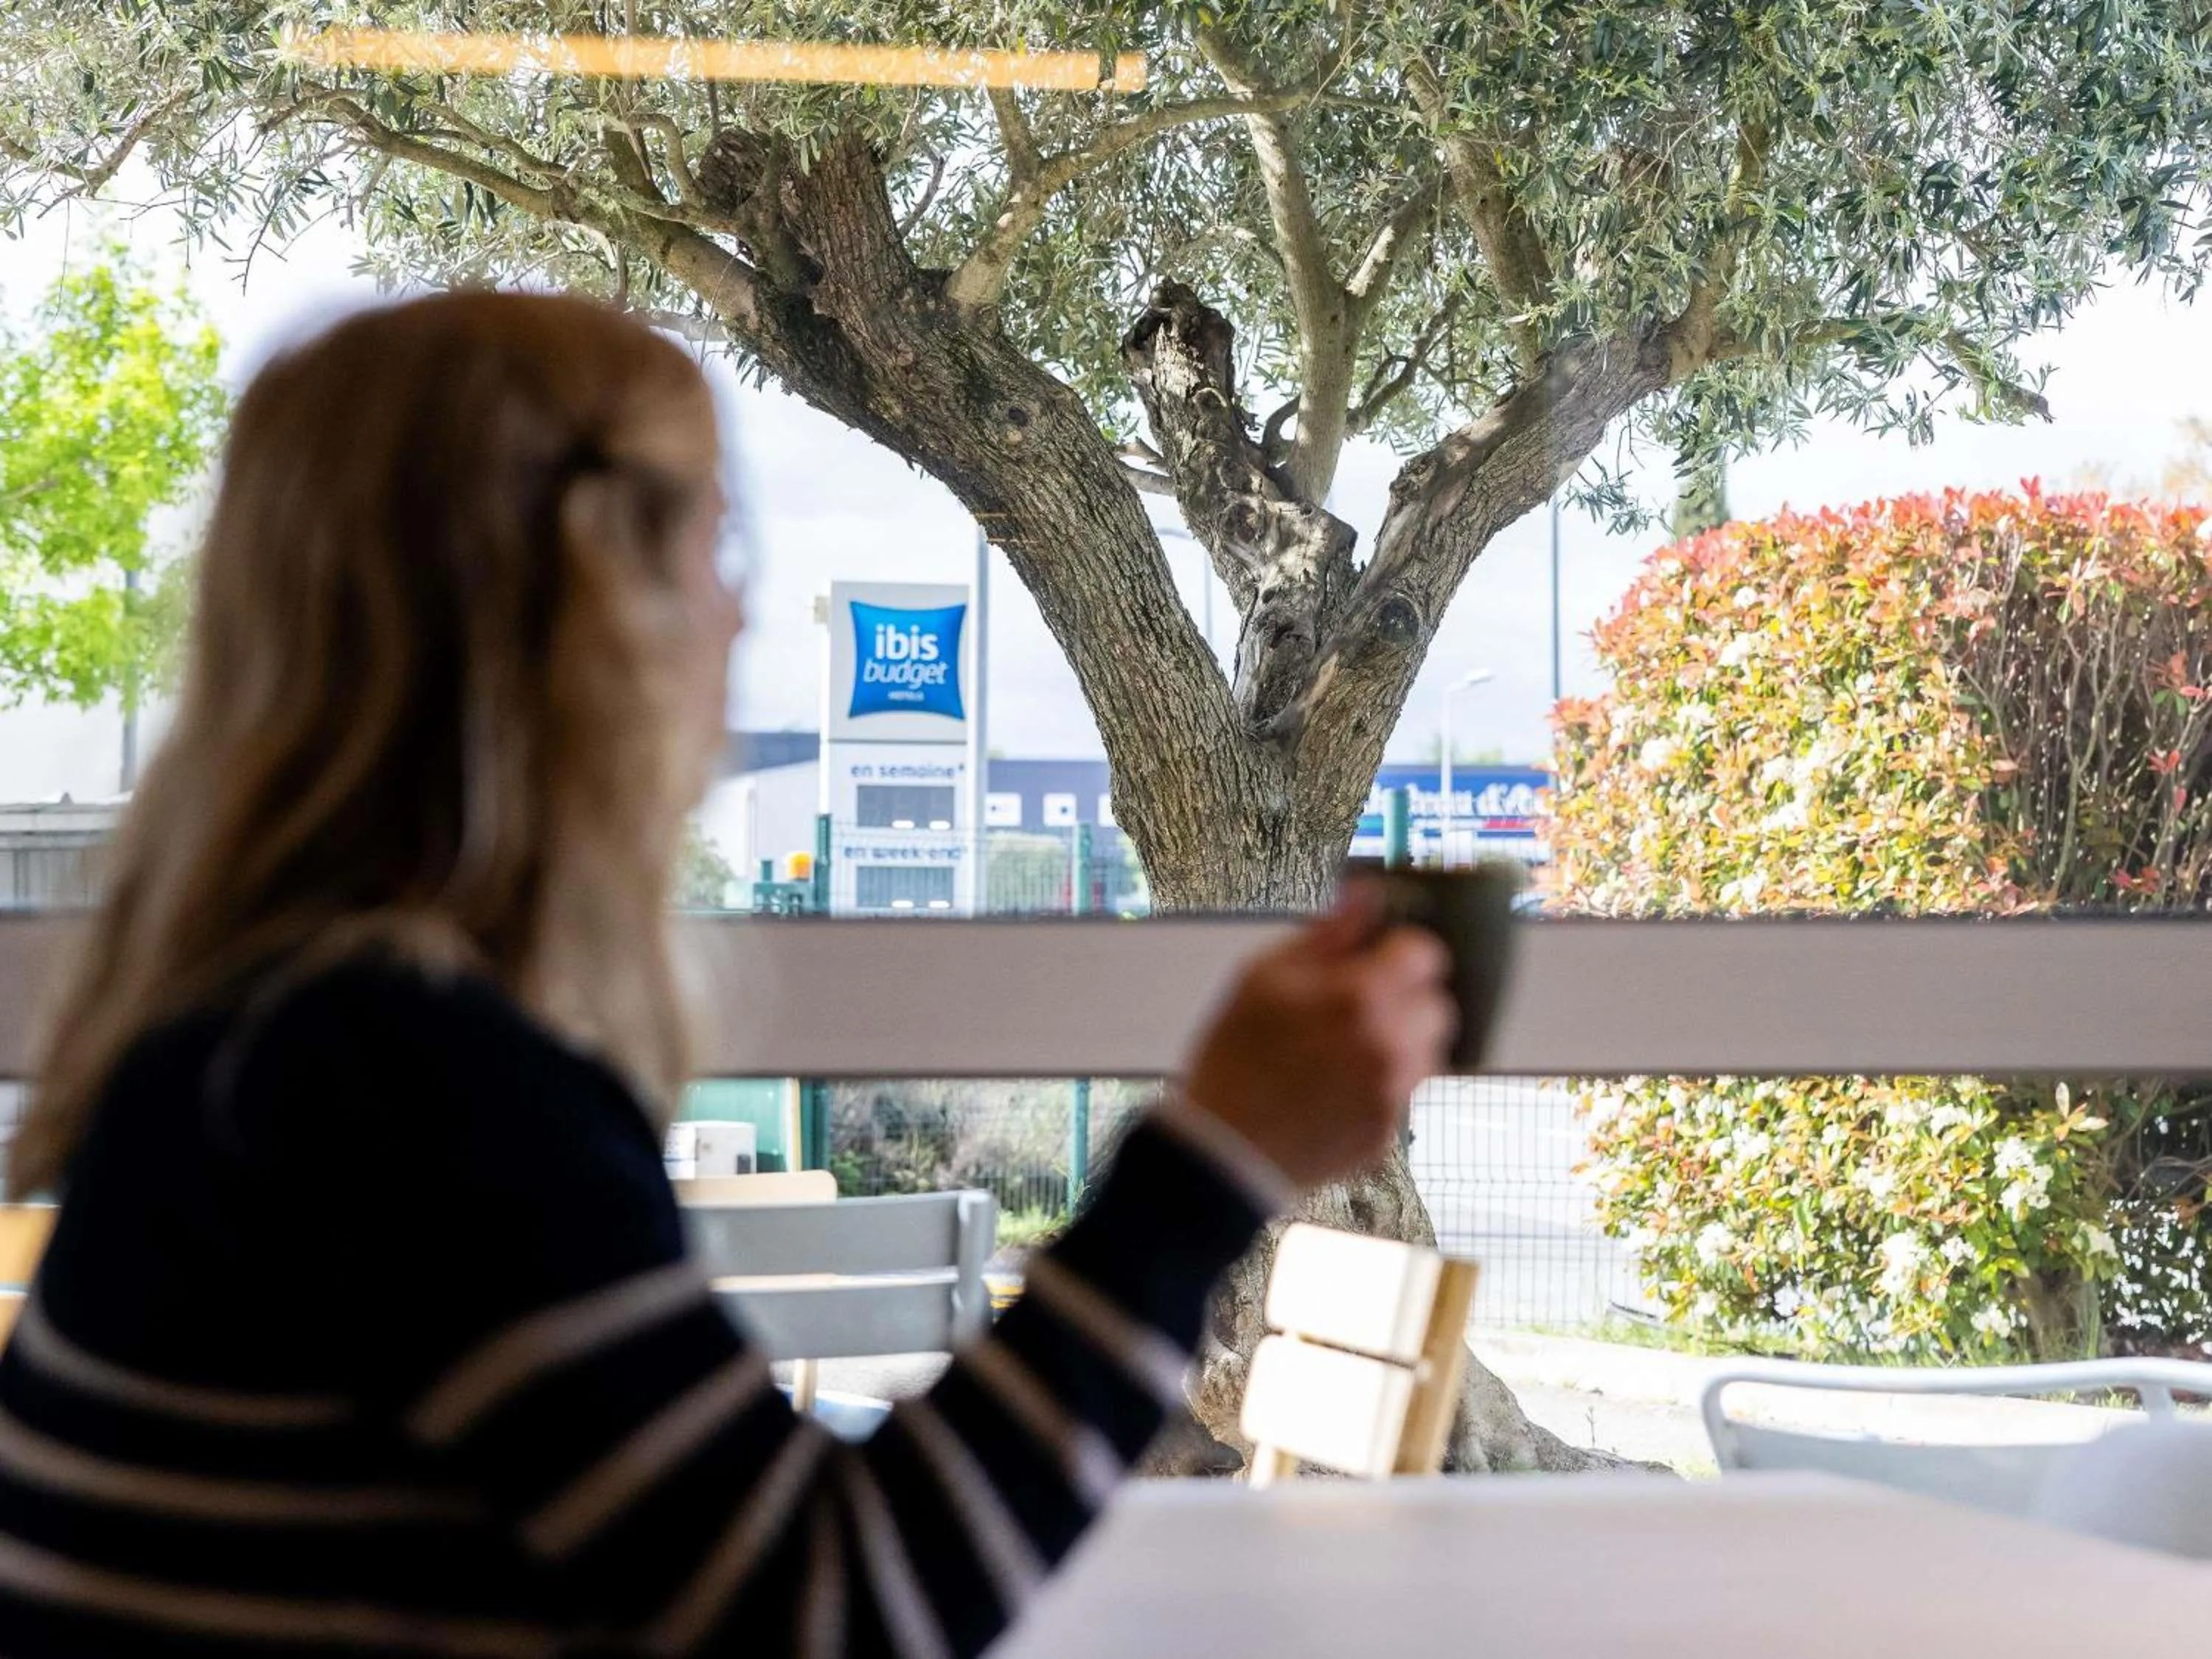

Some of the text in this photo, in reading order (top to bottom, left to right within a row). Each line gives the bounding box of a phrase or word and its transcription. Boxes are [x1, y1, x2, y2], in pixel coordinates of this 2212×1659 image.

[874, 624, 939, 661] ibis
[863, 658, 950, 689] budget
[850, 764, 873, 778] en
[844, 846, 866, 860] en
